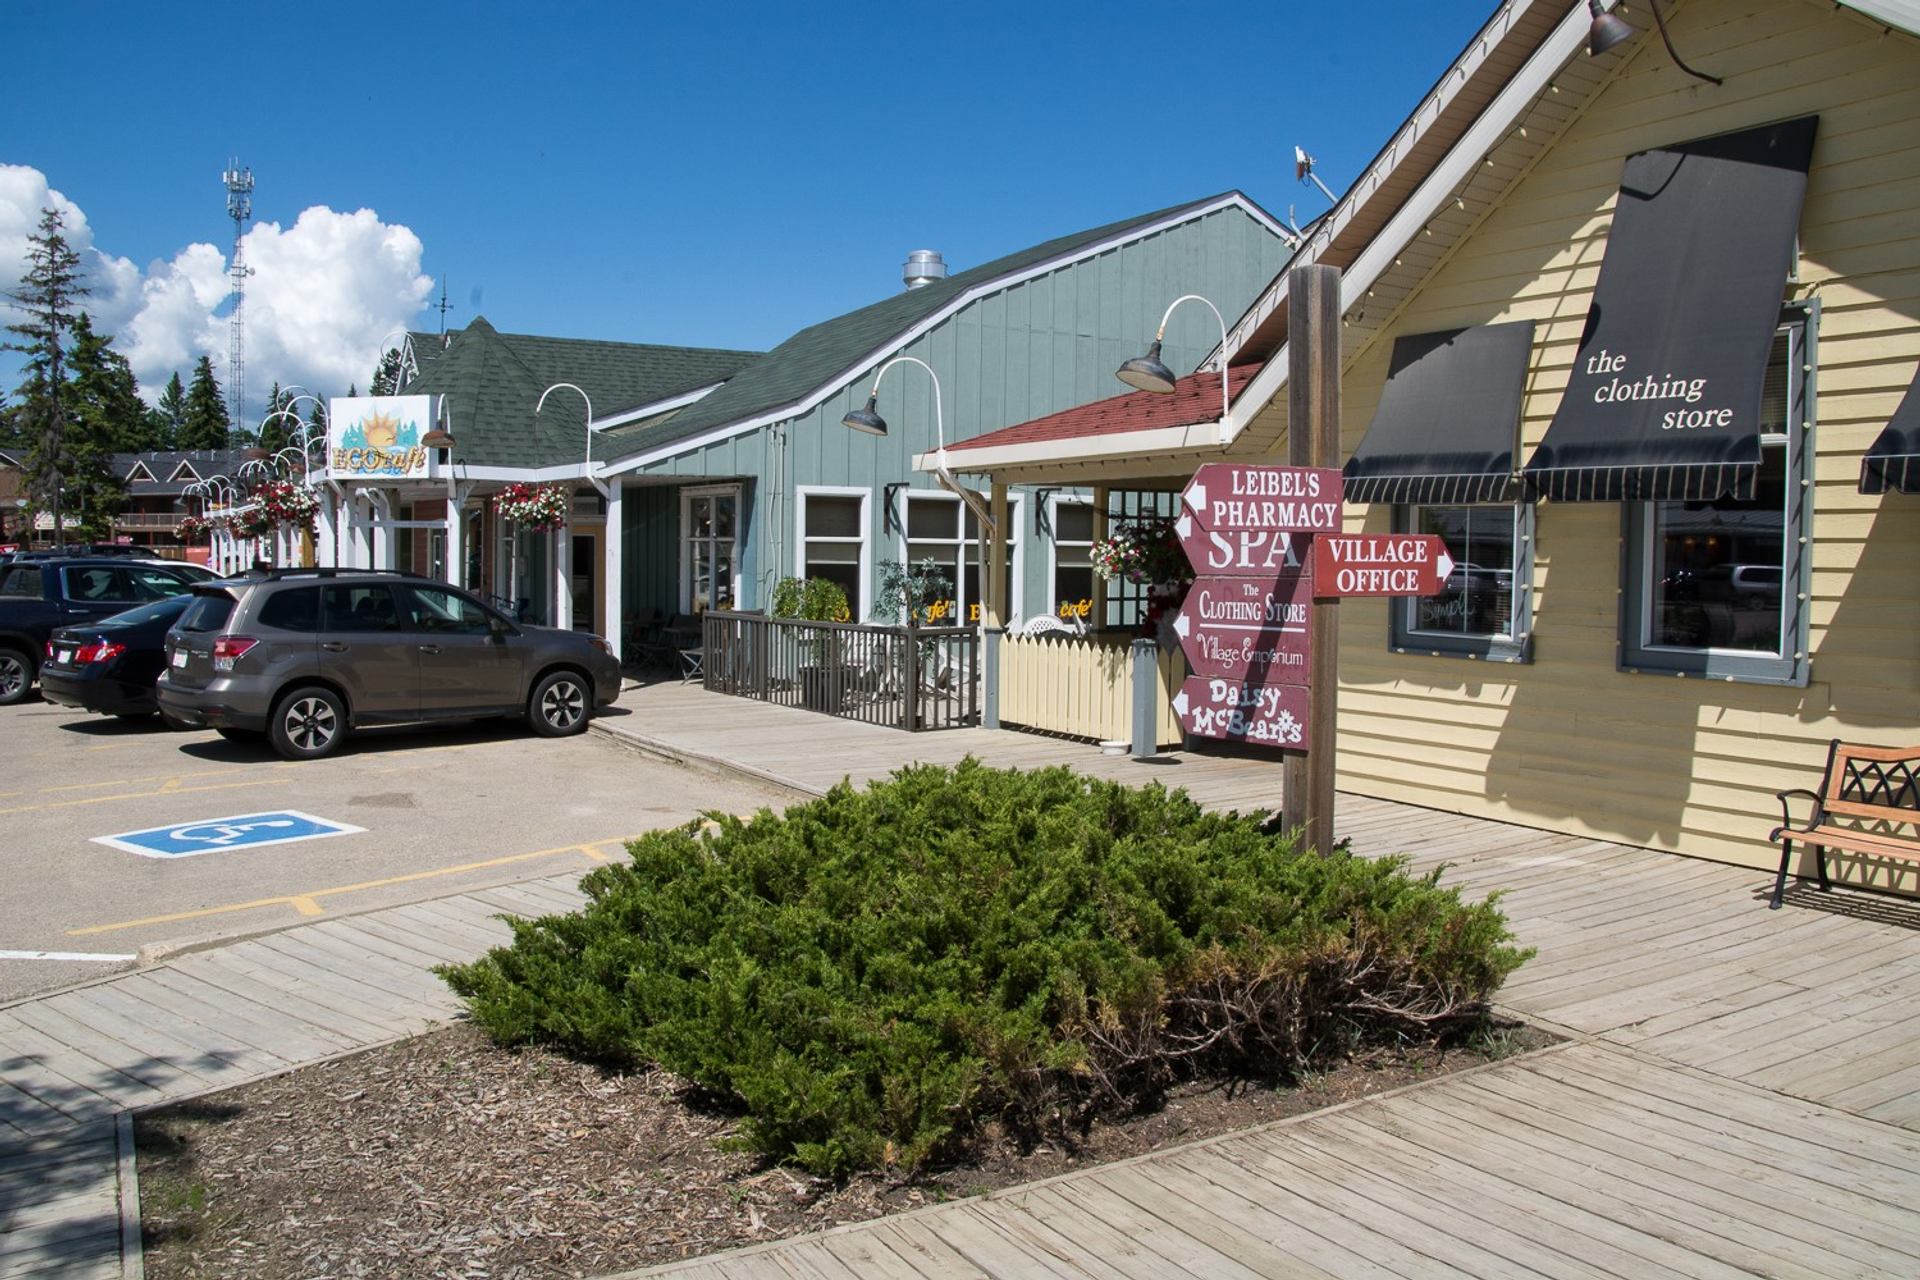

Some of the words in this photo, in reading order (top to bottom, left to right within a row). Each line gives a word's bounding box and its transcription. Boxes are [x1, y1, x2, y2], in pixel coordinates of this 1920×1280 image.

[1586, 350, 1626, 375] the
[1594, 373, 1706, 403] clothing
[1662, 408, 1733, 430] store
[1232, 470, 1320, 497] LEIBEL'S
[1213, 501, 1338, 528] PHARMACY
[1208, 531, 1301, 568] SPA
[1328, 539, 1428, 563] VILLAGE
[1243, 583, 1259, 597] The
[1337, 568, 1419, 592] OFFICE
[1199, 590, 1262, 621] CLOTHING
[1265, 592, 1307, 623] STORE
[1196, 632, 1240, 669] Village
[1241, 637, 1303, 674] Emporium
[1209, 679, 1281, 718] Daisy
